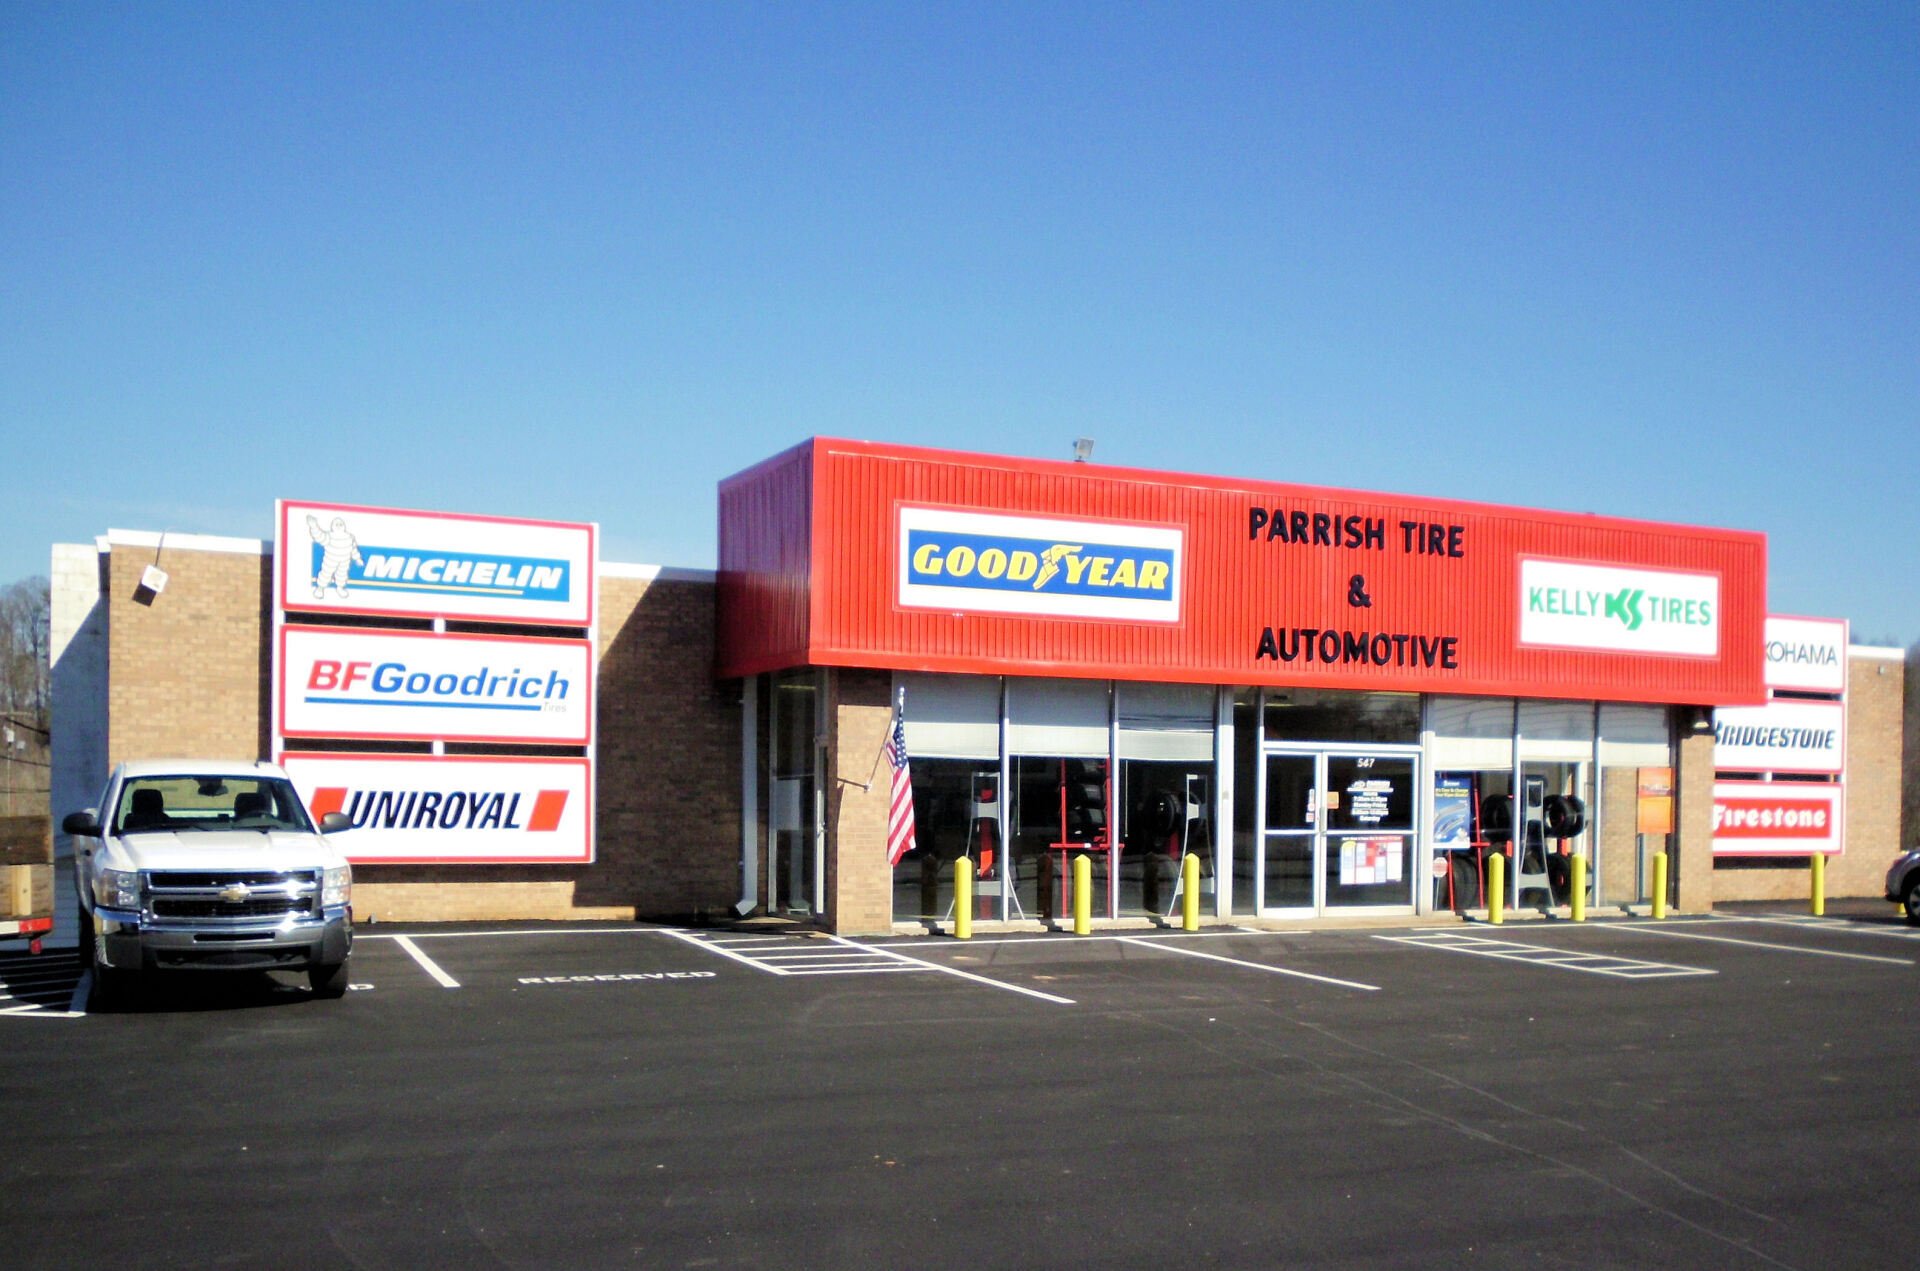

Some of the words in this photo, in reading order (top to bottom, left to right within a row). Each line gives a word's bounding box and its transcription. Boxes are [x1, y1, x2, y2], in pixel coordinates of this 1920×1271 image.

[1249, 507, 1385, 550] PARRISH
[1399, 520, 1465, 558] TIRE
[363, 554, 563, 589] MICHELIN
[913, 543, 1170, 590] GOODYEAR
[1347, 574, 1372, 608] &
[1529, 586, 1600, 617] KELLY
[1648, 596, 1712, 626] TIRES
[1255, 627, 1459, 669] AUTOMOTIVE
[306, 660, 570, 699] BFGoodrich
[1357, 758, 1376, 768] 547
[350, 790, 522, 829] UNIROYAL
[1712, 804, 1826, 831] Firestone
[517, 971, 717, 984] RESERVED
